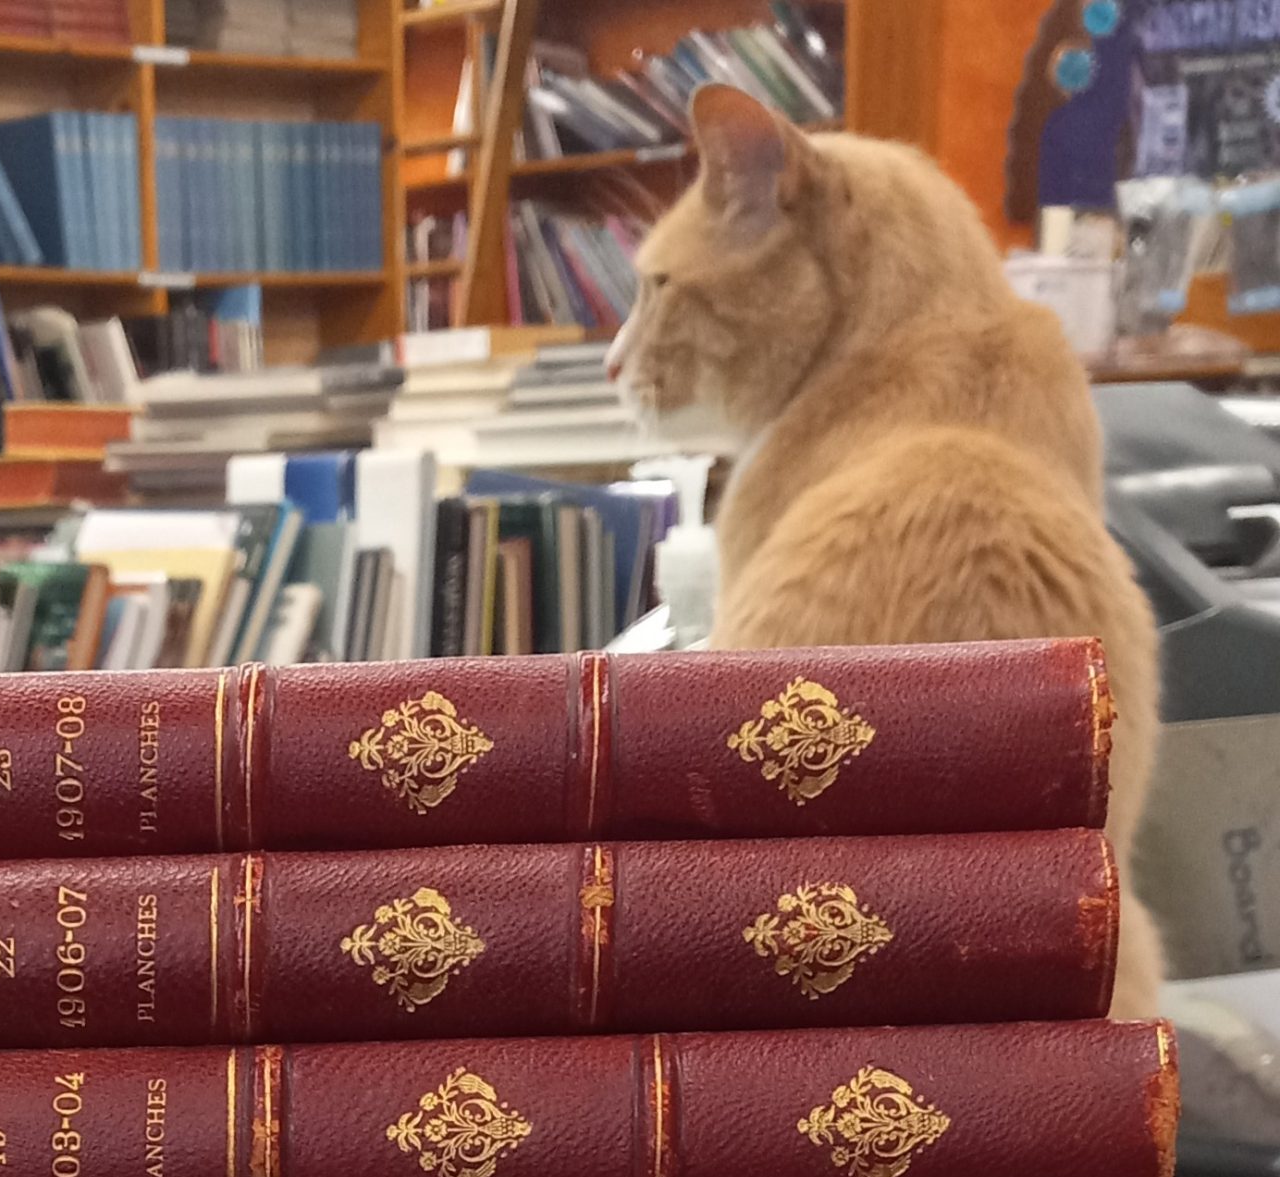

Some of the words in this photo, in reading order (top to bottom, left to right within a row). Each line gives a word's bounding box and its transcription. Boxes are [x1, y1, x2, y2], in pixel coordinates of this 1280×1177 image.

[55, 697, 86, 840] 1907-08
[140, 701, 160, 832] PLANCHES
[57, 886, 87, 1028] 1906-07
[137, 894, 157, 1022] PLANCHES
